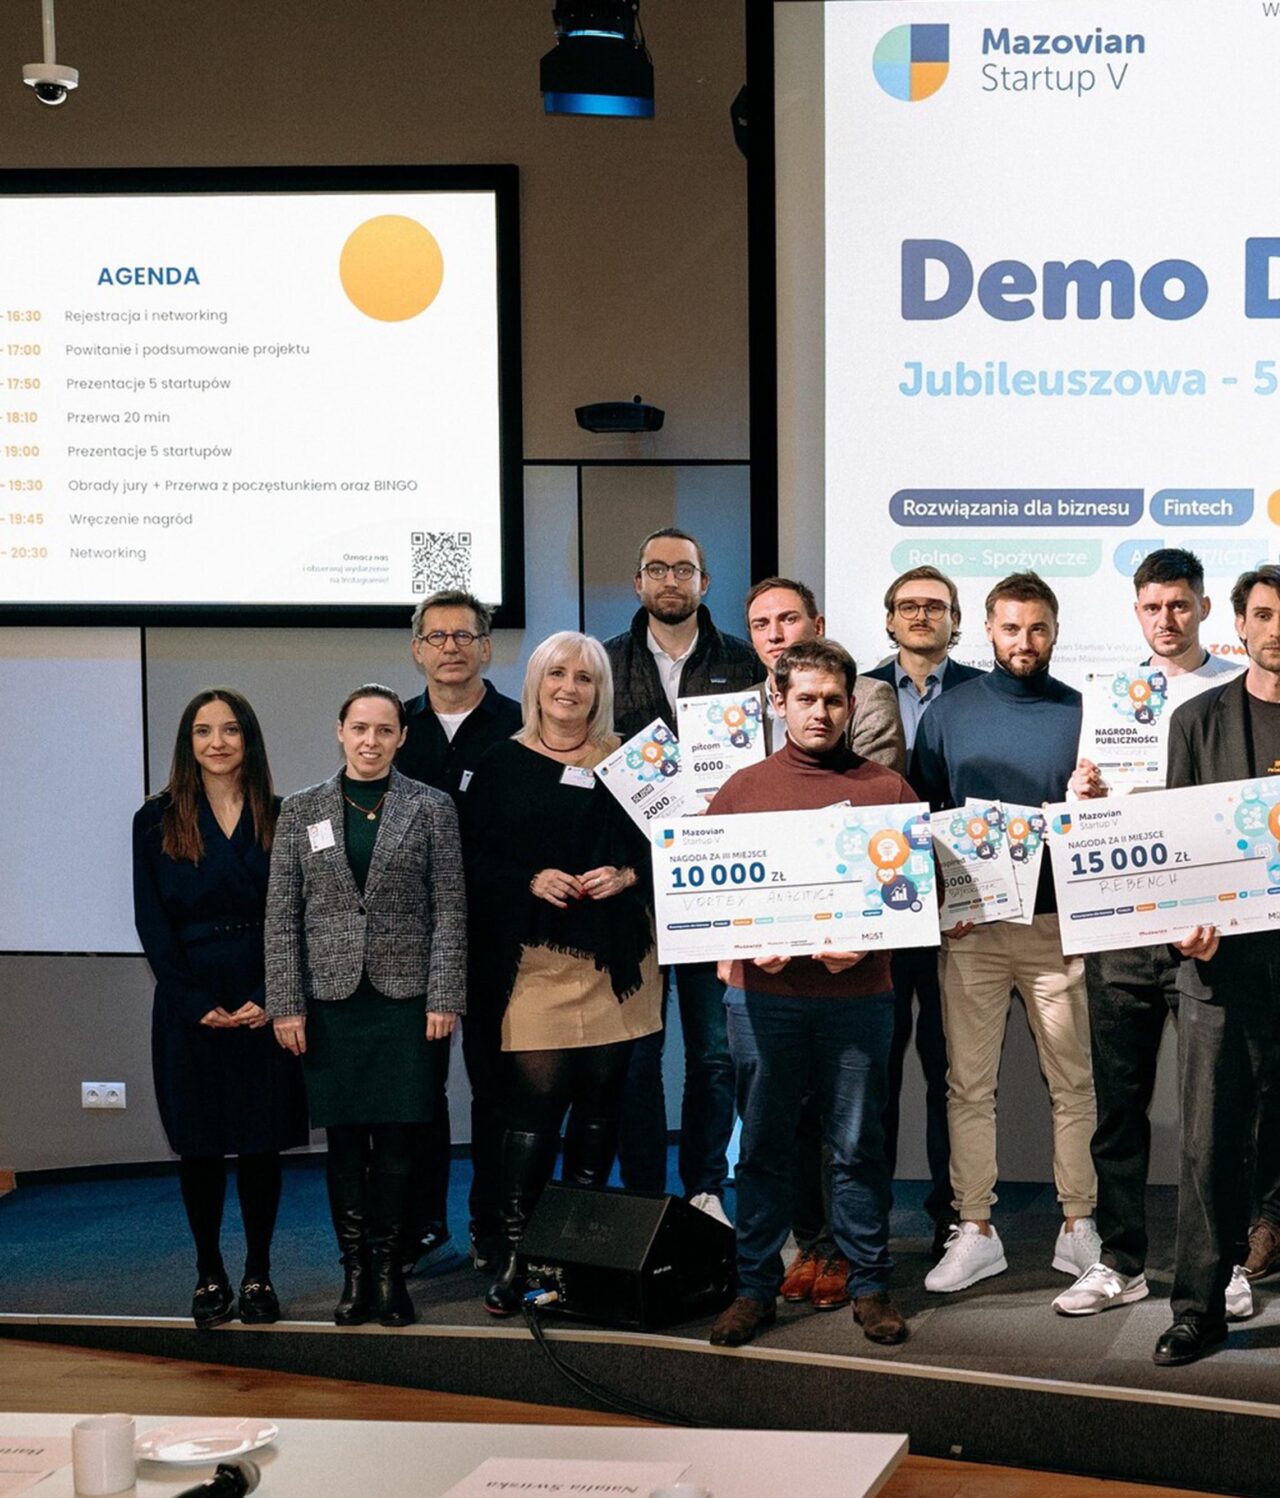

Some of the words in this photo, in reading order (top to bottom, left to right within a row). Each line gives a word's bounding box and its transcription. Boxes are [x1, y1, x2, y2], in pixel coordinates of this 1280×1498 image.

[981, 27, 1146, 55] Mazovian
[981, 62, 1096, 97] Startup
[1107, 63, 1129, 91] V
[97, 267, 201, 286] AGENDA
[900, 238, 1209, 322] Demo
[7, 310, 41, 322] 16:30
[65, 310, 141, 325] Rejestracja
[152, 308, 228, 325] networking
[7, 344, 41, 356] 17:00
[66, 343, 132, 356] Powitanie
[143, 342, 249, 358] podsumowanie
[253, 343, 311, 358] projektu
[7, 378, 41, 390] 17:50
[66, 378, 146, 392] Prezentacje
[150, 378, 158, 390] 5
[161, 377, 232, 392] startupów
[899, 361, 1207, 400] Jubileuszowa
[1253, 361, 1278, 395] 5
[6, 412, 38, 424] 18:10
[67, 411, 120, 424] Przerwa
[124, 411, 141, 424] 20
[144, 411, 170, 424] min
[5, 446, 40, 457] 19:00
[67, 445, 147, 460] Prezentacje
[151, 446, 159, 457] 5
[163, 445, 232, 460] startupów
[9, 480, 43, 492] 19:30
[68, 479, 119, 494] Obrady
[122, 480, 148, 494] jury
[165, 480, 218, 492] Przerwa
[232, 479, 337, 494] poczęstunkiem
[340, 482, 370, 492] oraz
[374, 480, 418, 492] BINGO
[903, 499, 1019, 520] Rozwiązania
[1023, 499, 1052, 516] dla
[1058, 499, 1130, 516] biznesu
[1164, 498, 1233, 516] Fintech
[9, 513, 44, 525] 19:45
[69, 513, 139, 528] Wręczenie
[143, 512, 193, 528] nagród
[11, 547, 48, 559] 20:30
[70, 547, 147, 562] Networking
[909, 550, 963, 567] Rolno
[983, 550, 1088, 569] Spożywcze
[1095, 728, 1138, 736] NAGRODA
[694, 760, 724, 773] 6000
[643, 796, 671, 820] 2000
[1078, 808, 1122, 822] Mazovian
[682, 827, 725, 837] Mazovian
[1068, 837, 1107, 850] NAGODA
[1108, 836, 1120, 846] ZA
[1128, 831, 1165, 844] MIEJSCE
[669, 852, 708, 864] NAGODA
[709, 852, 721, 862] ZA
[732, 850, 768, 860] MIEJSCE
[1071, 850, 1105, 875] 15
[1111, 843, 1168, 869] 000
[1175, 852, 1191, 863] ZŁ
[671, 865, 705, 889] 10
[711, 862, 766, 886] 000
[771, 872, 787, 882] ZŁ
[1099, 873, 1177, 894] REBENCH
